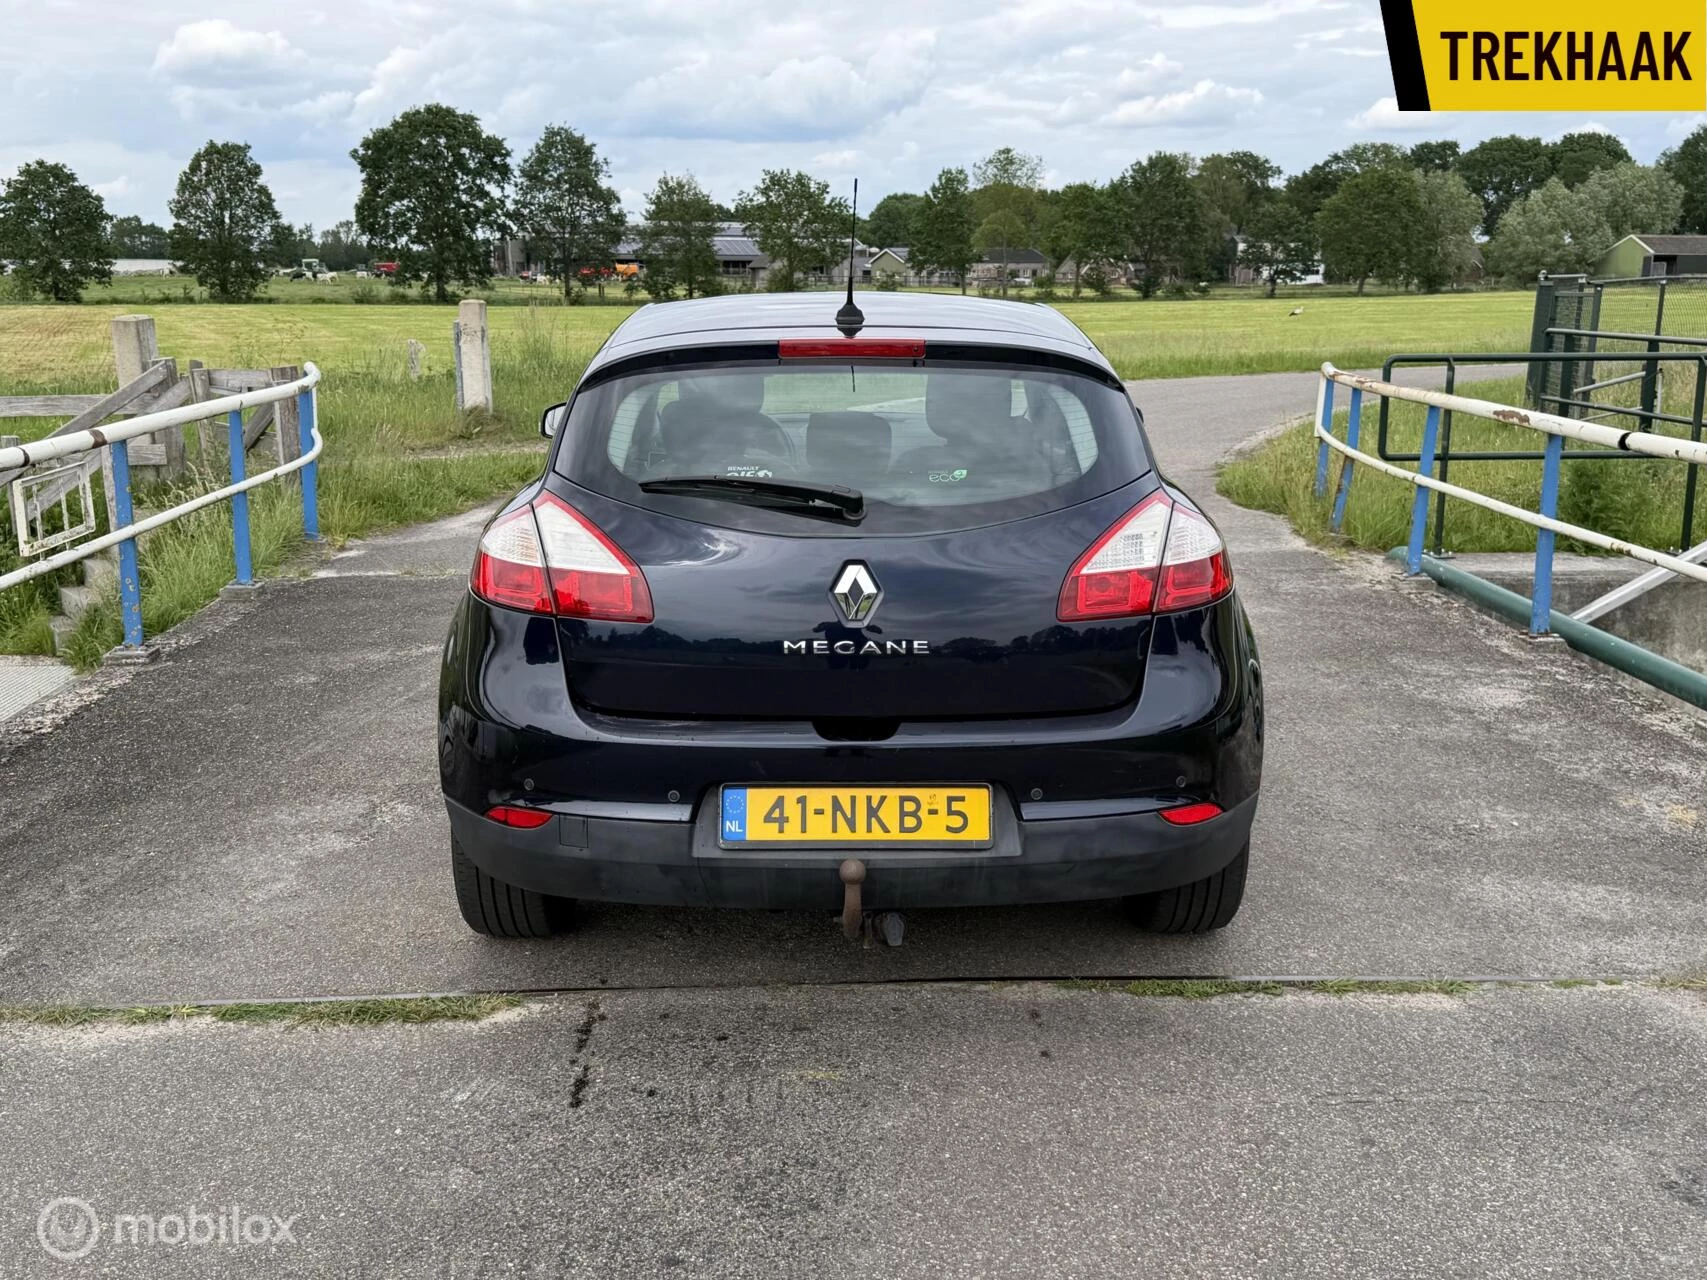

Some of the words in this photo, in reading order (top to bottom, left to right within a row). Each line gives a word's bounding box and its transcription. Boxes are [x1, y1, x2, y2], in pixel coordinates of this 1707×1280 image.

[783, 640, 930, 655] MEGANE
[763, 795, 969, 834] 41-NKB-5
[726, 820, 743, 833] NL
